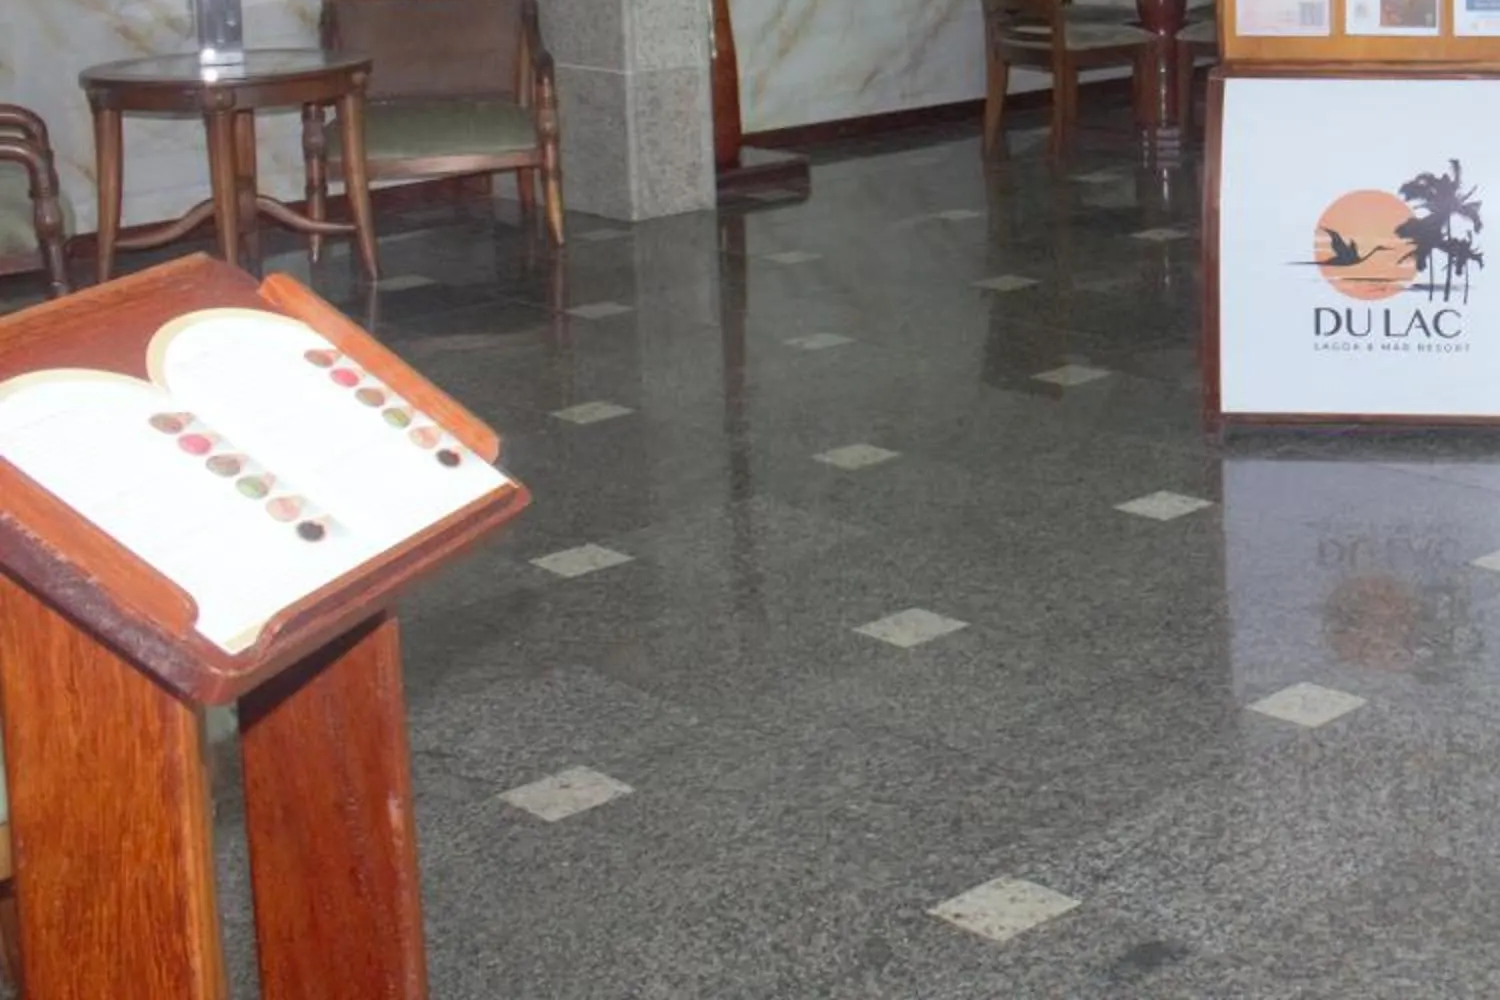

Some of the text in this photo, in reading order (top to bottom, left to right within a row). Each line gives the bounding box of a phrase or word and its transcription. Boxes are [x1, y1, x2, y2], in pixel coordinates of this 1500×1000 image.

[1314, 307, 1462, 339] DU LAC
[1314, 343, 1361, 352] LAGOA
[1418, 343, 1470, 353] RESORT
